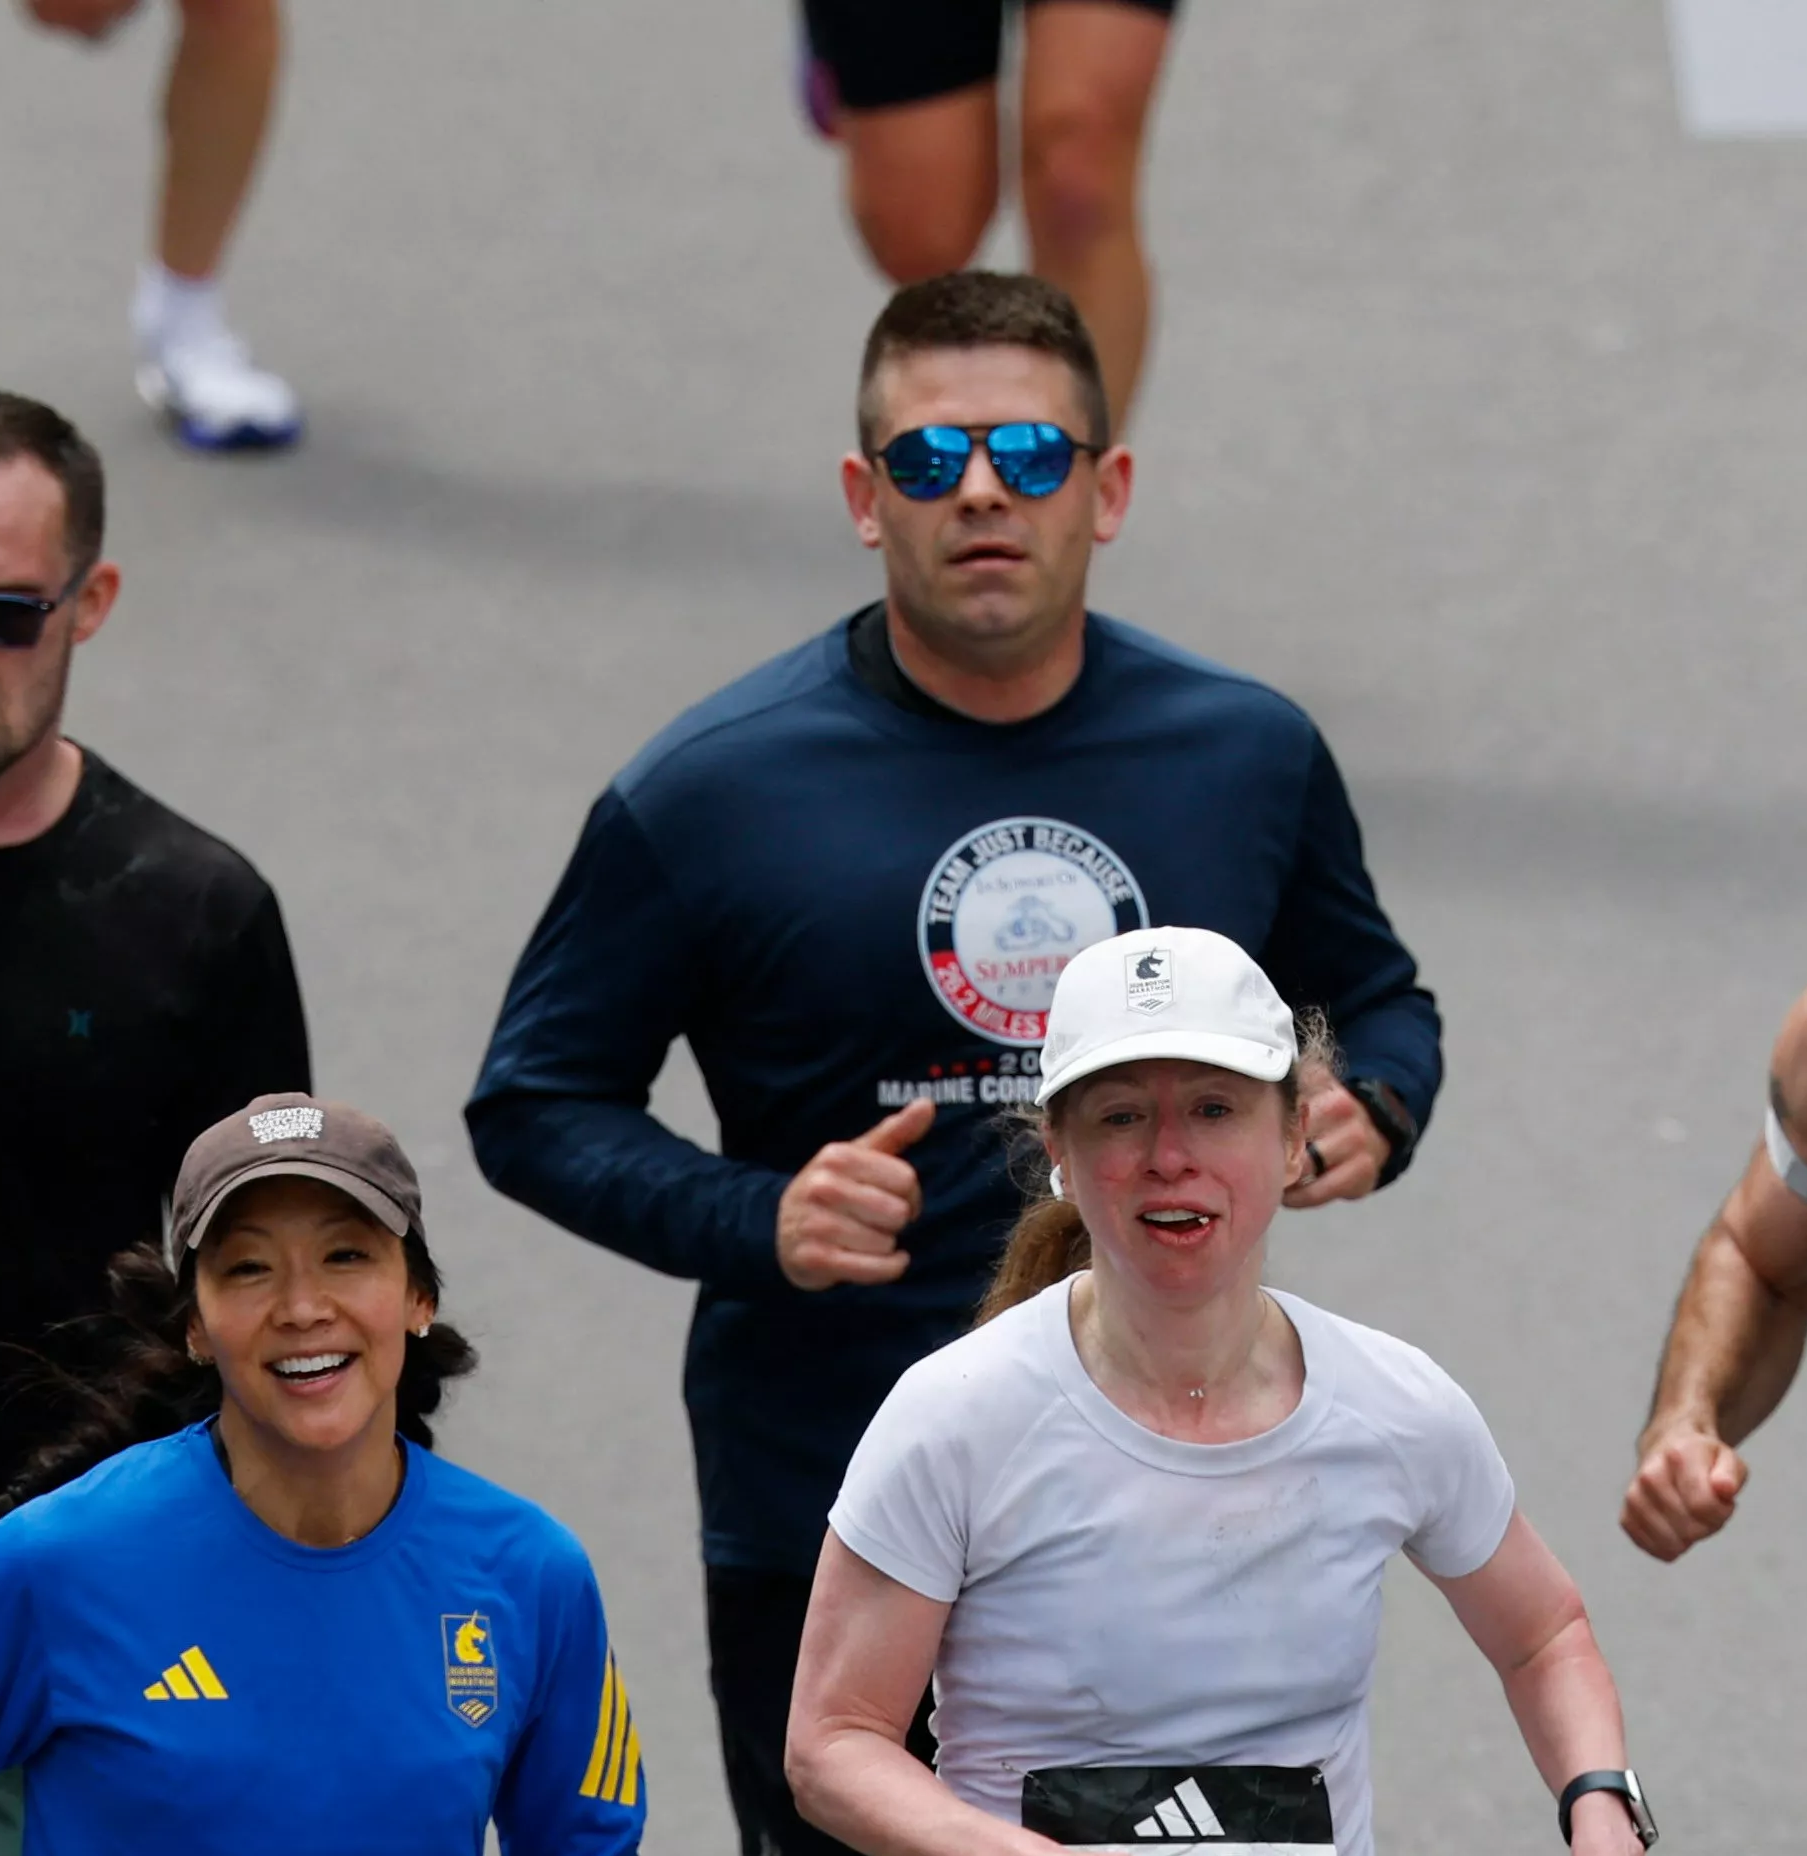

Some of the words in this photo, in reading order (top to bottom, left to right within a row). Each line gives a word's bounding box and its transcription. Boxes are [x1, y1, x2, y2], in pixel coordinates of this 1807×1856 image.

[927, 856, 974, 925] TEAM
[970, 826, 1028, 866] JUST
[1032, 826, 1133, 906] BECAUSE
[998, 1051, 1040, 1074] 20
[877, 1076, 976, 1107] MARINE
